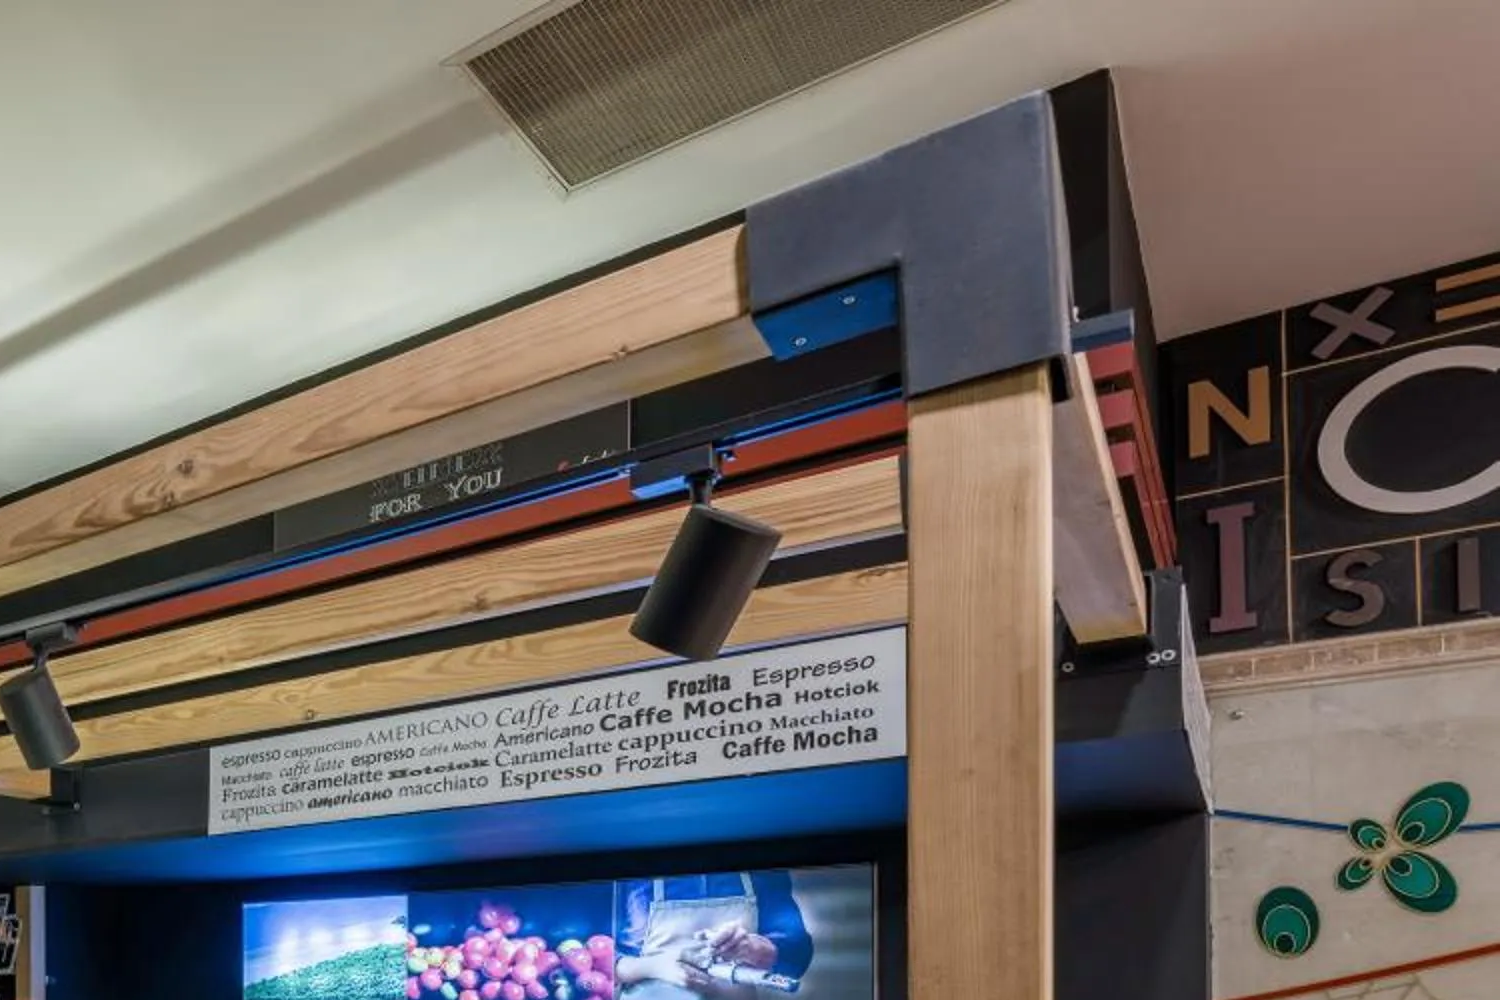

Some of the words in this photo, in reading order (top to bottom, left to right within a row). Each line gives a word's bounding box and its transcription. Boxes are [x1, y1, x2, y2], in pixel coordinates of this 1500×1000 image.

[1187, 365, 1272, 460] N
[369, 493, 422, 522] FOR
[444, 467, 503, 501] YOU
[1324, 549, 1385, 628] S
[221, 749, 281, 768] espresso
[283, 738, 363, 760] cappuccino
[364, 711, 489, 746] AMERICANO
[495, 699, 560, 731] Caffe
[568, 690, 641, 717] Latte
[666, 673, 731, 700] Frozita
[752, 654, 876, 689] Espresso
[222, 785, 277, 804] Frozita
[281, 768, 384, 795] caramelatte
[495, 740, 613, 768] Caramelatte
[618, 718, 763, 752] cappuccino
[769, 706, 874, 730] Macchiato
[351, 747, 415, 768] espresso
[493, 722, 595, 748] Americano
[599, 706, 673, 732] Caffe
[683, 691, 782, 721] Mocha
[794, 680, 880, 705] Hotciok
[221, 800, 304, 823] cappuccino
[307, 787, 393, 810] americano
[399, 774, 489, 797] macchiato
[500, 762, 602, 789] Espresso
[615, 751, 697, 774] Frozita
[722, 736, 786, 760] Caffe
[793, 725, 878, 751] Mocha
